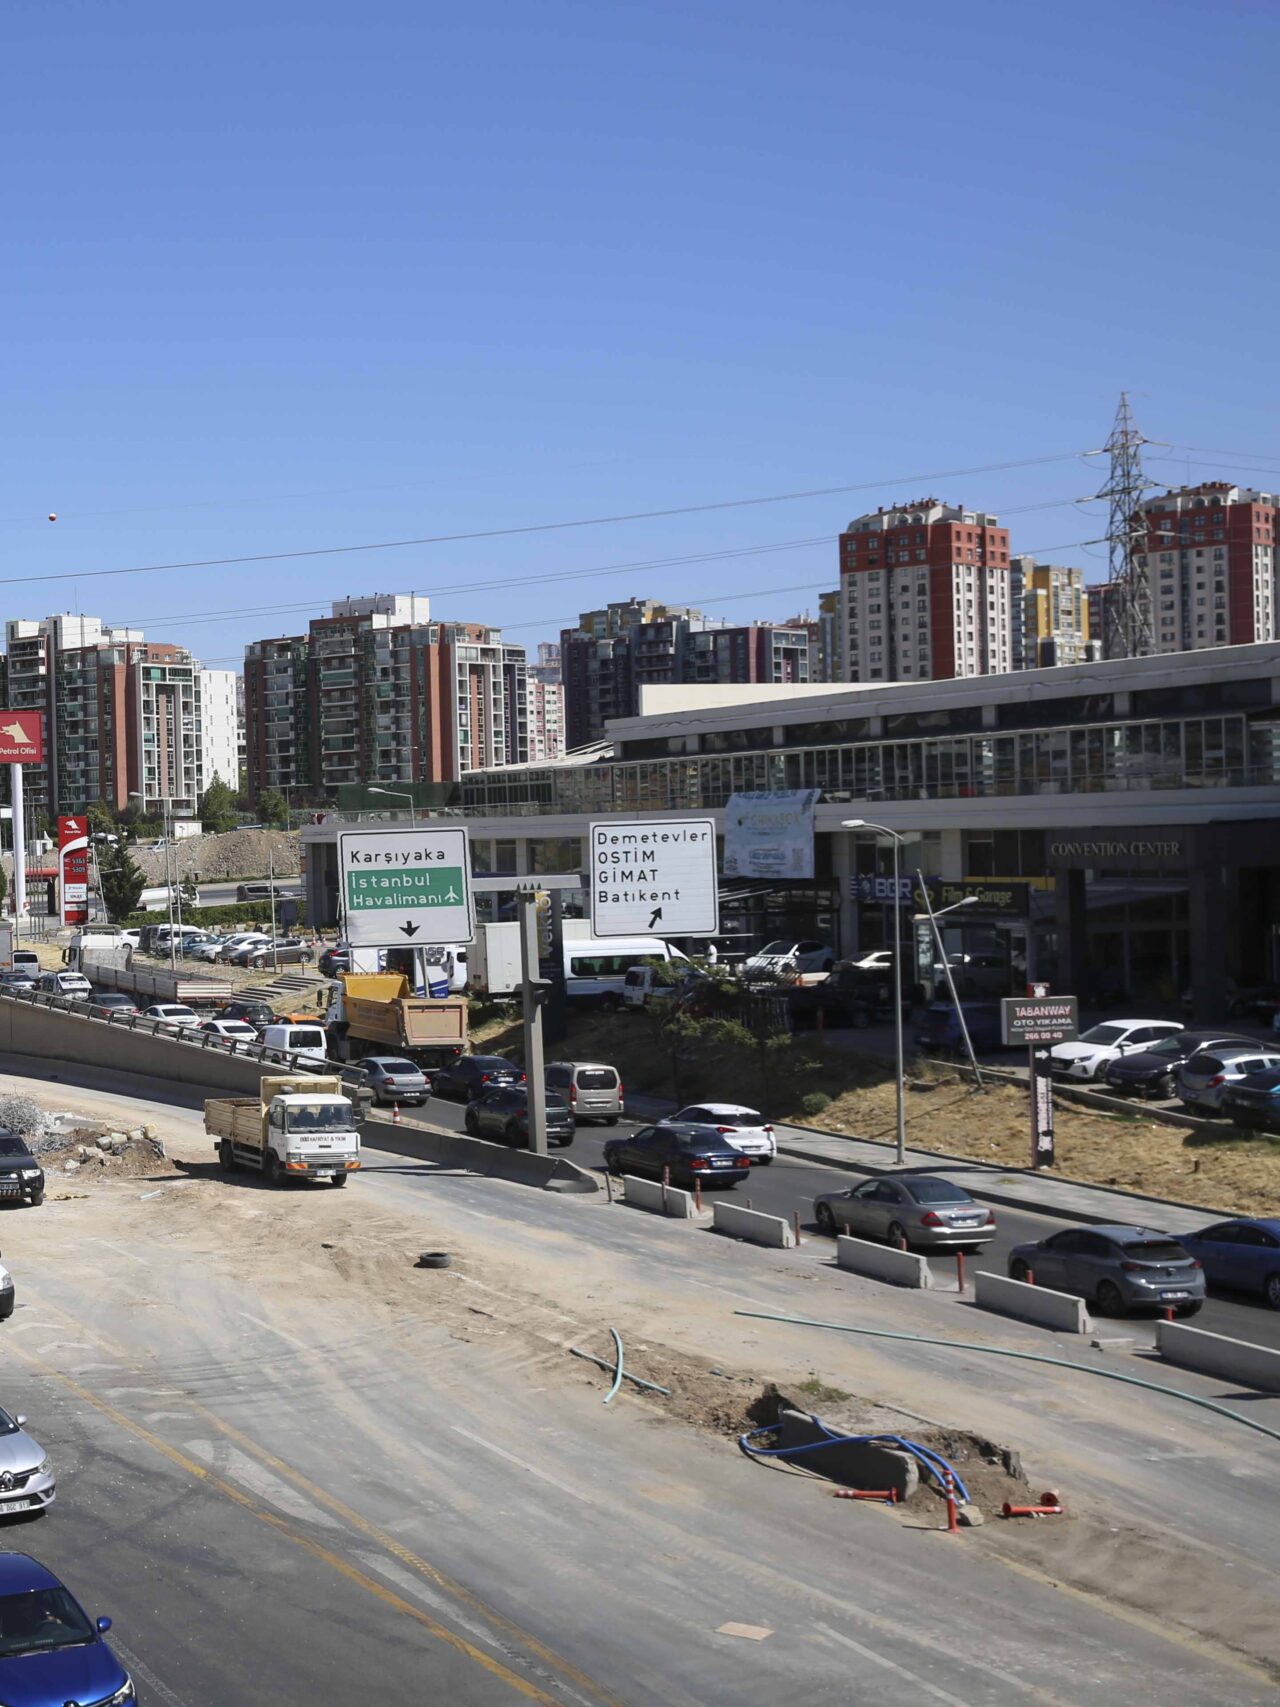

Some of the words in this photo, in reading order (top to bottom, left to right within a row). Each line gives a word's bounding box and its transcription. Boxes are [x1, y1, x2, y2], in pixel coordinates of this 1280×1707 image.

[20, 747, 37, 755] Ofisi
[597, 829, 708, 845] Demetevler
[350, 848, 445, 865] Karşıyaka
[598, 847, 655, 864] OSTİM
[1051, 841, 1128, 857] CONVENTION
[1130, 841, 1180, 856] CENTER
[352, 873, 430, 889] İstanbul
[598, 867, 658, 883] GİMAT
[353, 893, 442, 907] Havalimanı
[598, 889, 680, 903] Batıkent
[975, 887, 1013, 906] Garage
[1015, 1005, 1071, 1017] TABANWAY
